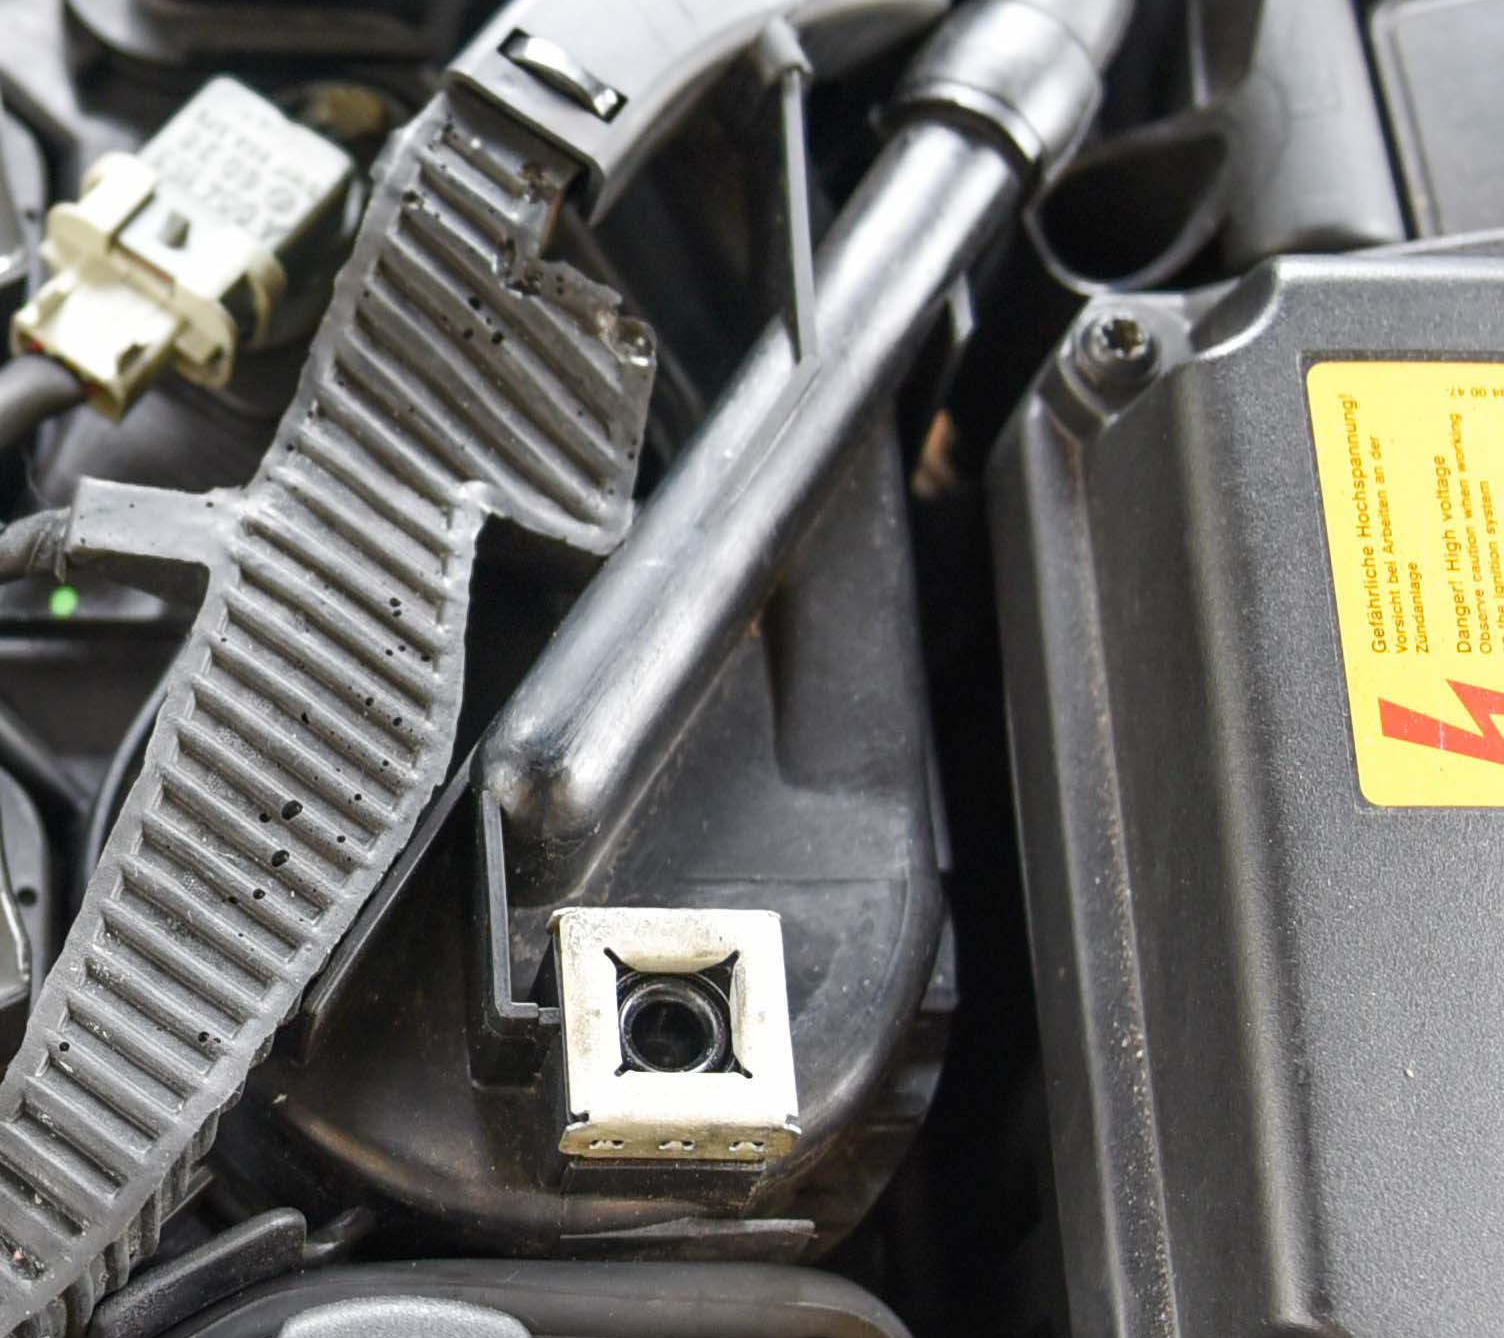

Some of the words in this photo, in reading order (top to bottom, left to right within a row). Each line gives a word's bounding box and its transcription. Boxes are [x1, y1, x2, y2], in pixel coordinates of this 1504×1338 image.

[1337, 392, 1371, 538] Hochspannung!
[1369, 435, 1382, 460] der
[1450, 413, 1466, 473] working
[1374, 465, 1385, 484] an
[1434, 455, 1452, 522] voltage
[1460, 479, 1472, 519] when
[1377, 490, 1394, 555] Arbeiten
[1480, 481, 1497, 535] system
[1384, 561, 1399, 584] bei
[1442, 529, 1461, 572] High
[1466, 526, 1482, 582] caution
[1360, 545, 1388, 654] Gefährliche
[1389, 590, 1408, 654] Vorsicht
[1448, 580, 1472, 653] Danger!
[1475, 588, 1492, 654] Observe
